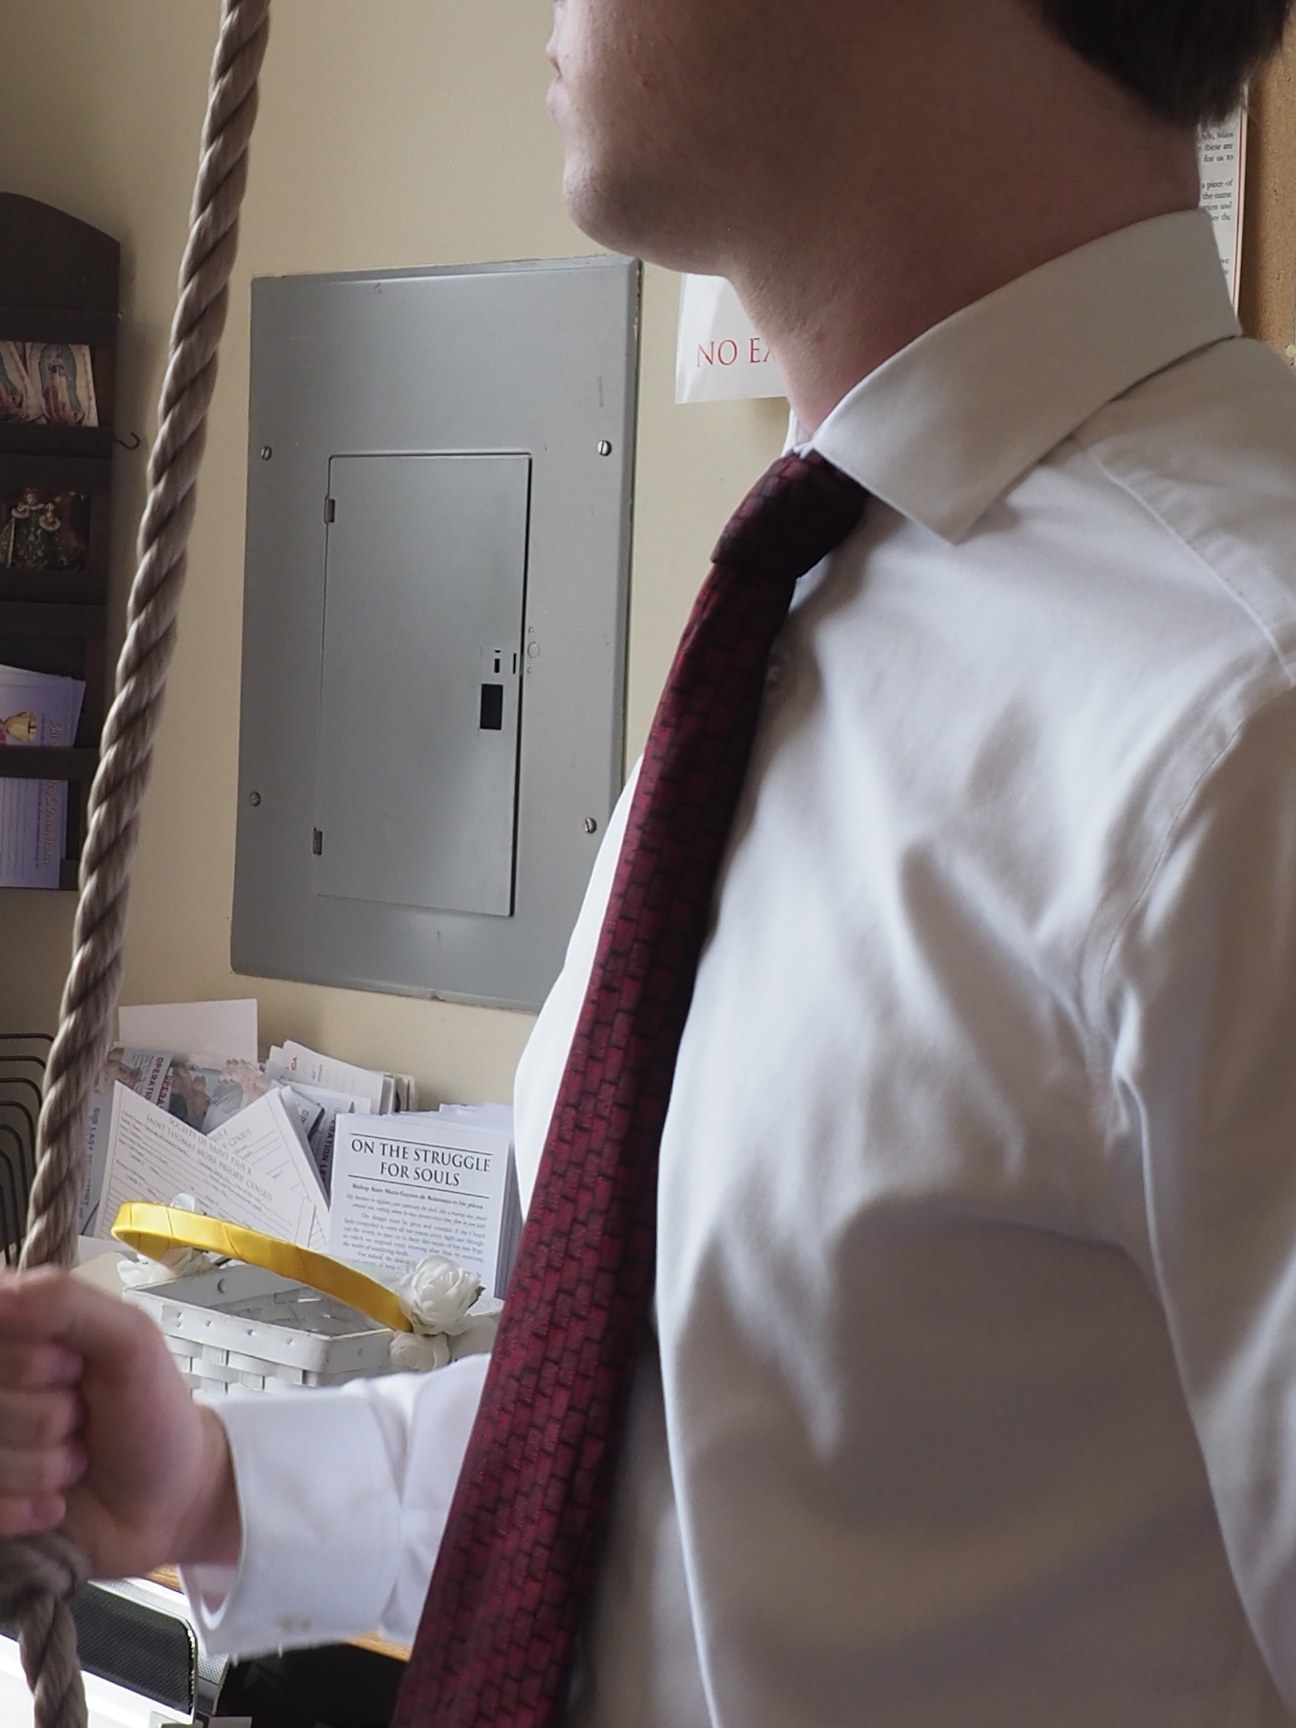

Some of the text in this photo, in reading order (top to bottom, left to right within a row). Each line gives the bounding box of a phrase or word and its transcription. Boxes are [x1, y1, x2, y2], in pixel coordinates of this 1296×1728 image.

[352, 1139, 491, 1173] ON THE STRUGGLE
[381, 1161, 459, 1186] FOR SOULS
